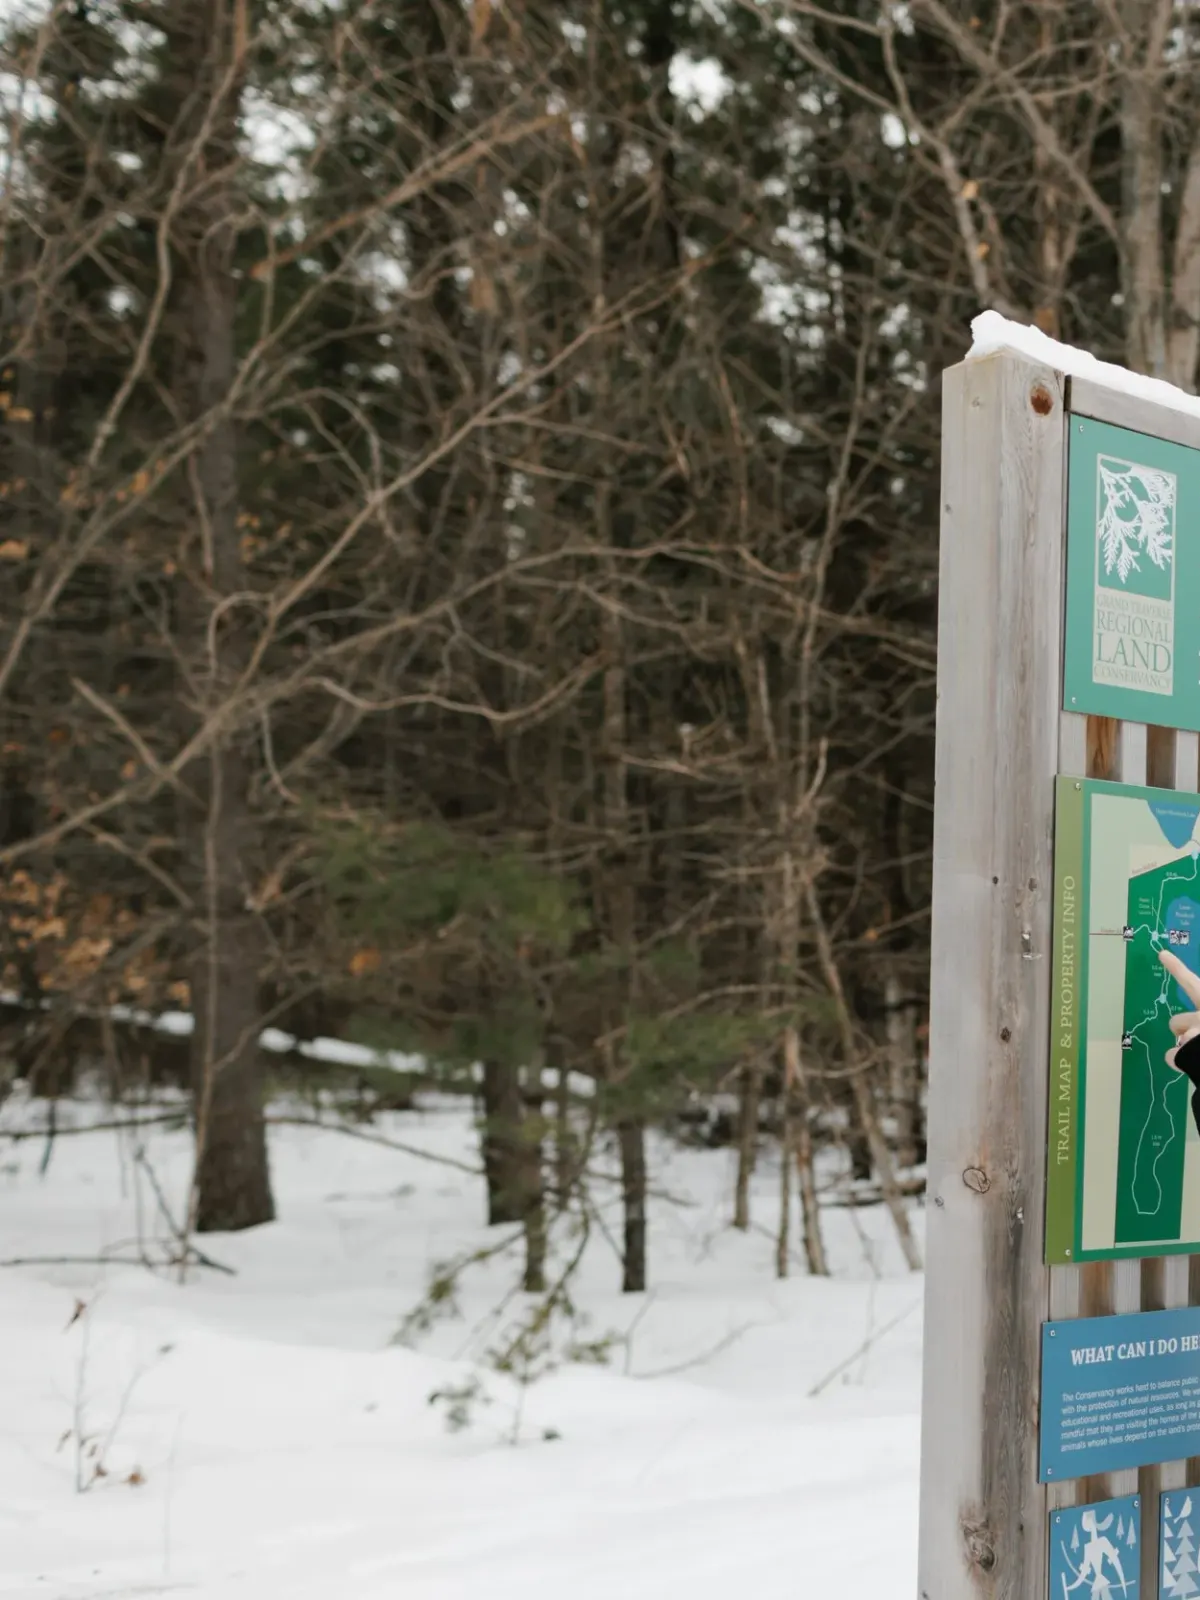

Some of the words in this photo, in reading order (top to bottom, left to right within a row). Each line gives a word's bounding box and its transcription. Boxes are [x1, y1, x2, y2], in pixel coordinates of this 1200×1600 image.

[1097, 594, 1129, 611] GRAND
[1097, 610, 1172, 643] REGIONAL
[1096, 632, 1171, 673] LAND
[1094, 665, 1171, 689] CONSERVANCY
[1063, 876, 1075, 923] INFO
[1060, 929, 1074, 1028] PROPERTY
[1061, 1038, 1072, 1048] &
[1060, 1058, 1072, 1101] MAP
[1057, 1106, 1070, 1165] TRAIL
[1071, 1345, 1114, 1367] WHAT
[1117, 1341, 1146, 1361] CAN
[1149, 1341, 1155, 1356] I
[1158, 1337, 1178, 1356] DO
[1062, 1392, 1074, 1402] The
[1075, 1387, 1115, 1403] Conservancy
[1116, 1386, 1134, 1395] works
[1135, 1383, 1149, 1392] hard
[1150, 1382, 1156, 1390] to
[1158, 1379, 1180, 1389] balance
[1182, 1376, 1198, 1387] public
[1062, 1406, 1075, 1415] with
[1076, 1403, 1087, 1413] the
[1088, 1399, 1119, 1413] protection
[1121, 1398, 1128, 1406] of
[1128, 1395, 1148, 1405] natural
[1182, 1389, 1192, 1397] We
[1061, 1414, 1098, 1428] educational
[1099, 1412, 1111, 1422] and
[1113, 1407, 1148, 1420] recreational
[1167, 1404, 1174, 1412] as
[1175, 1402, 1188, 1412] long
[1061, 1428, 1085, 1440] mindful
[1086, 1426, 1099, 1436] that
[1100, 1425, 1113, 1436] they
[1126, 1419, 1148, 1432] visiting
[1149, 1417, 1158, 1426] the
[1160, 1414, 1179, 1424] homes
[1181, 1412, 1187, 1421] of
[1188, 1411, 1197, 1419] the
[1061, 1440, 1087, 1453] animals
[1087, 1438, 1108, 1448] whose
[1110, 1434, 1123, 1444] lives
[1124, 1431, 1147, 1444] depend
[1158, 1428, 1167, 1436] the
[1168, 1425, 1186, 1435] land's
